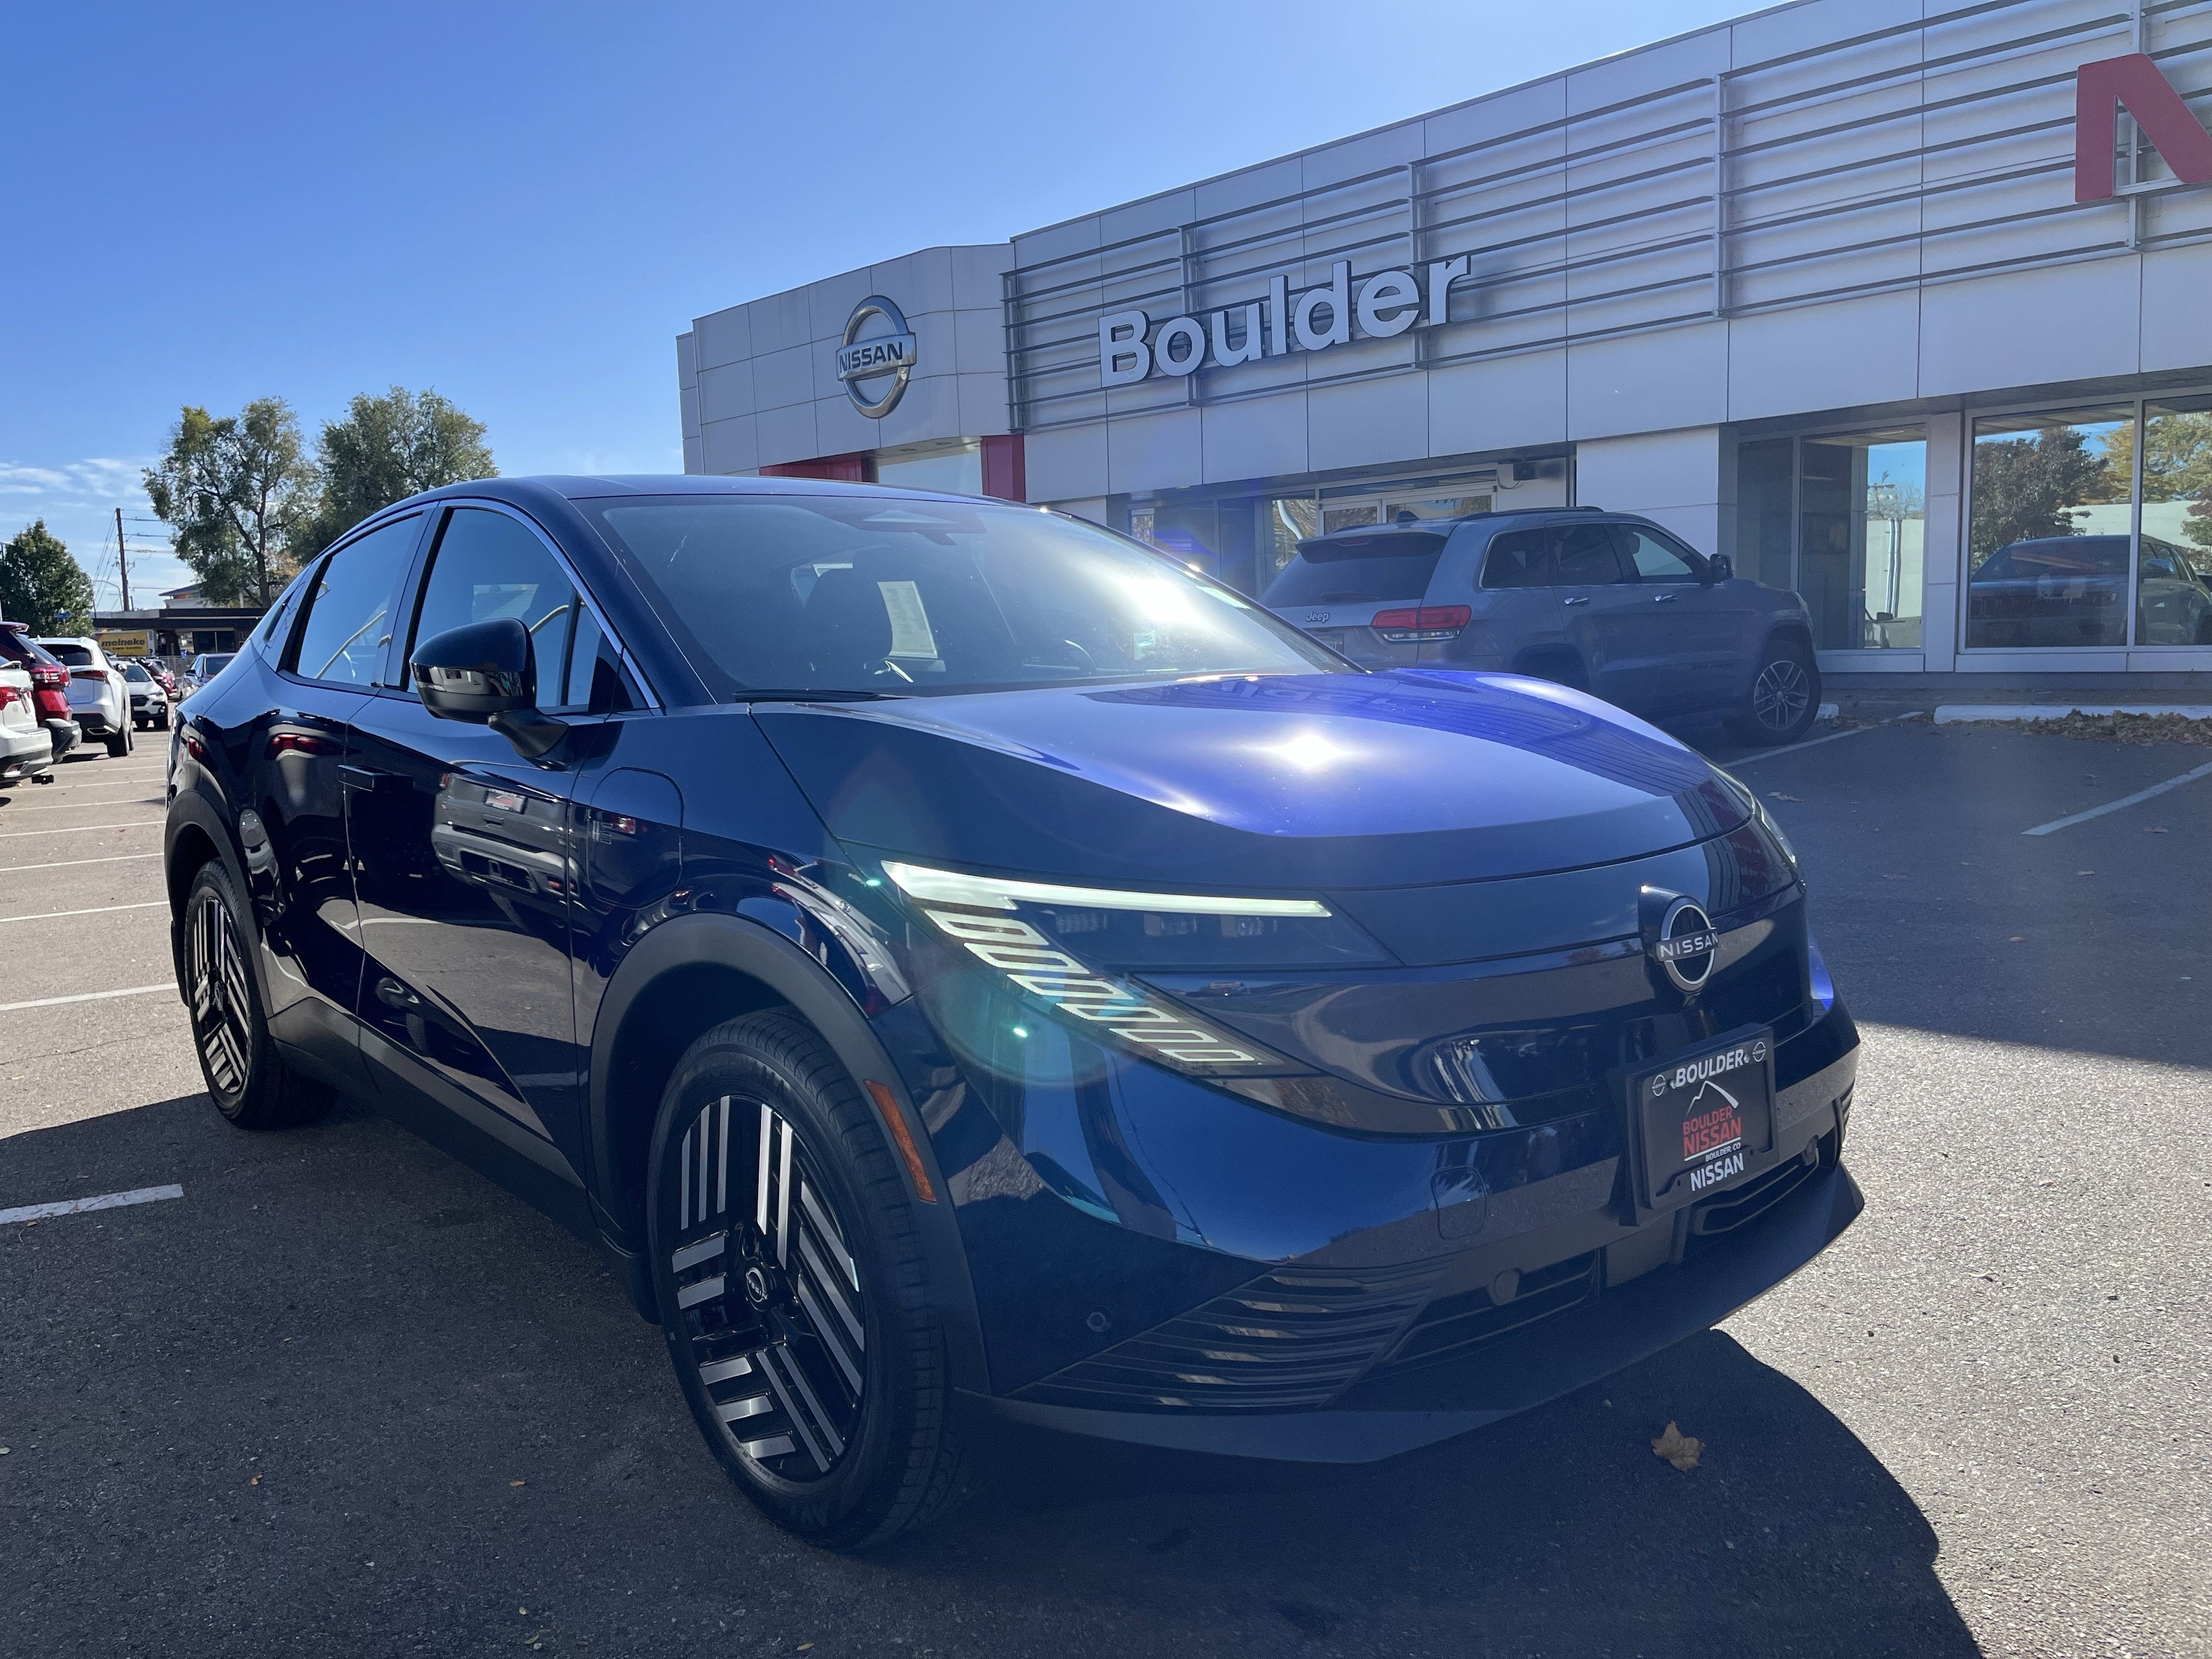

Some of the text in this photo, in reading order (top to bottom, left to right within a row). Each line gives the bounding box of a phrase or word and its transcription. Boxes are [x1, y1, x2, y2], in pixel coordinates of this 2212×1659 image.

[1098, 255, 1471, 388] Boulder
[839, 341, 903, 373] NISSAN
[1305, 611, 1330, 623] Jeep
[101, 638, 145, 646] meineke
[1660, 932, 1719, 958] NISSAN
[1676, 1048, 1744, 1088] BOULDER
[1683, 1105, 1733, 1136] BOULDER
[1684, 1116, 1741, 1158] NISSAN
[1733, 1142, 1741, 1150] CO
[1690, 1153, 1744, 1192] NISSAN
